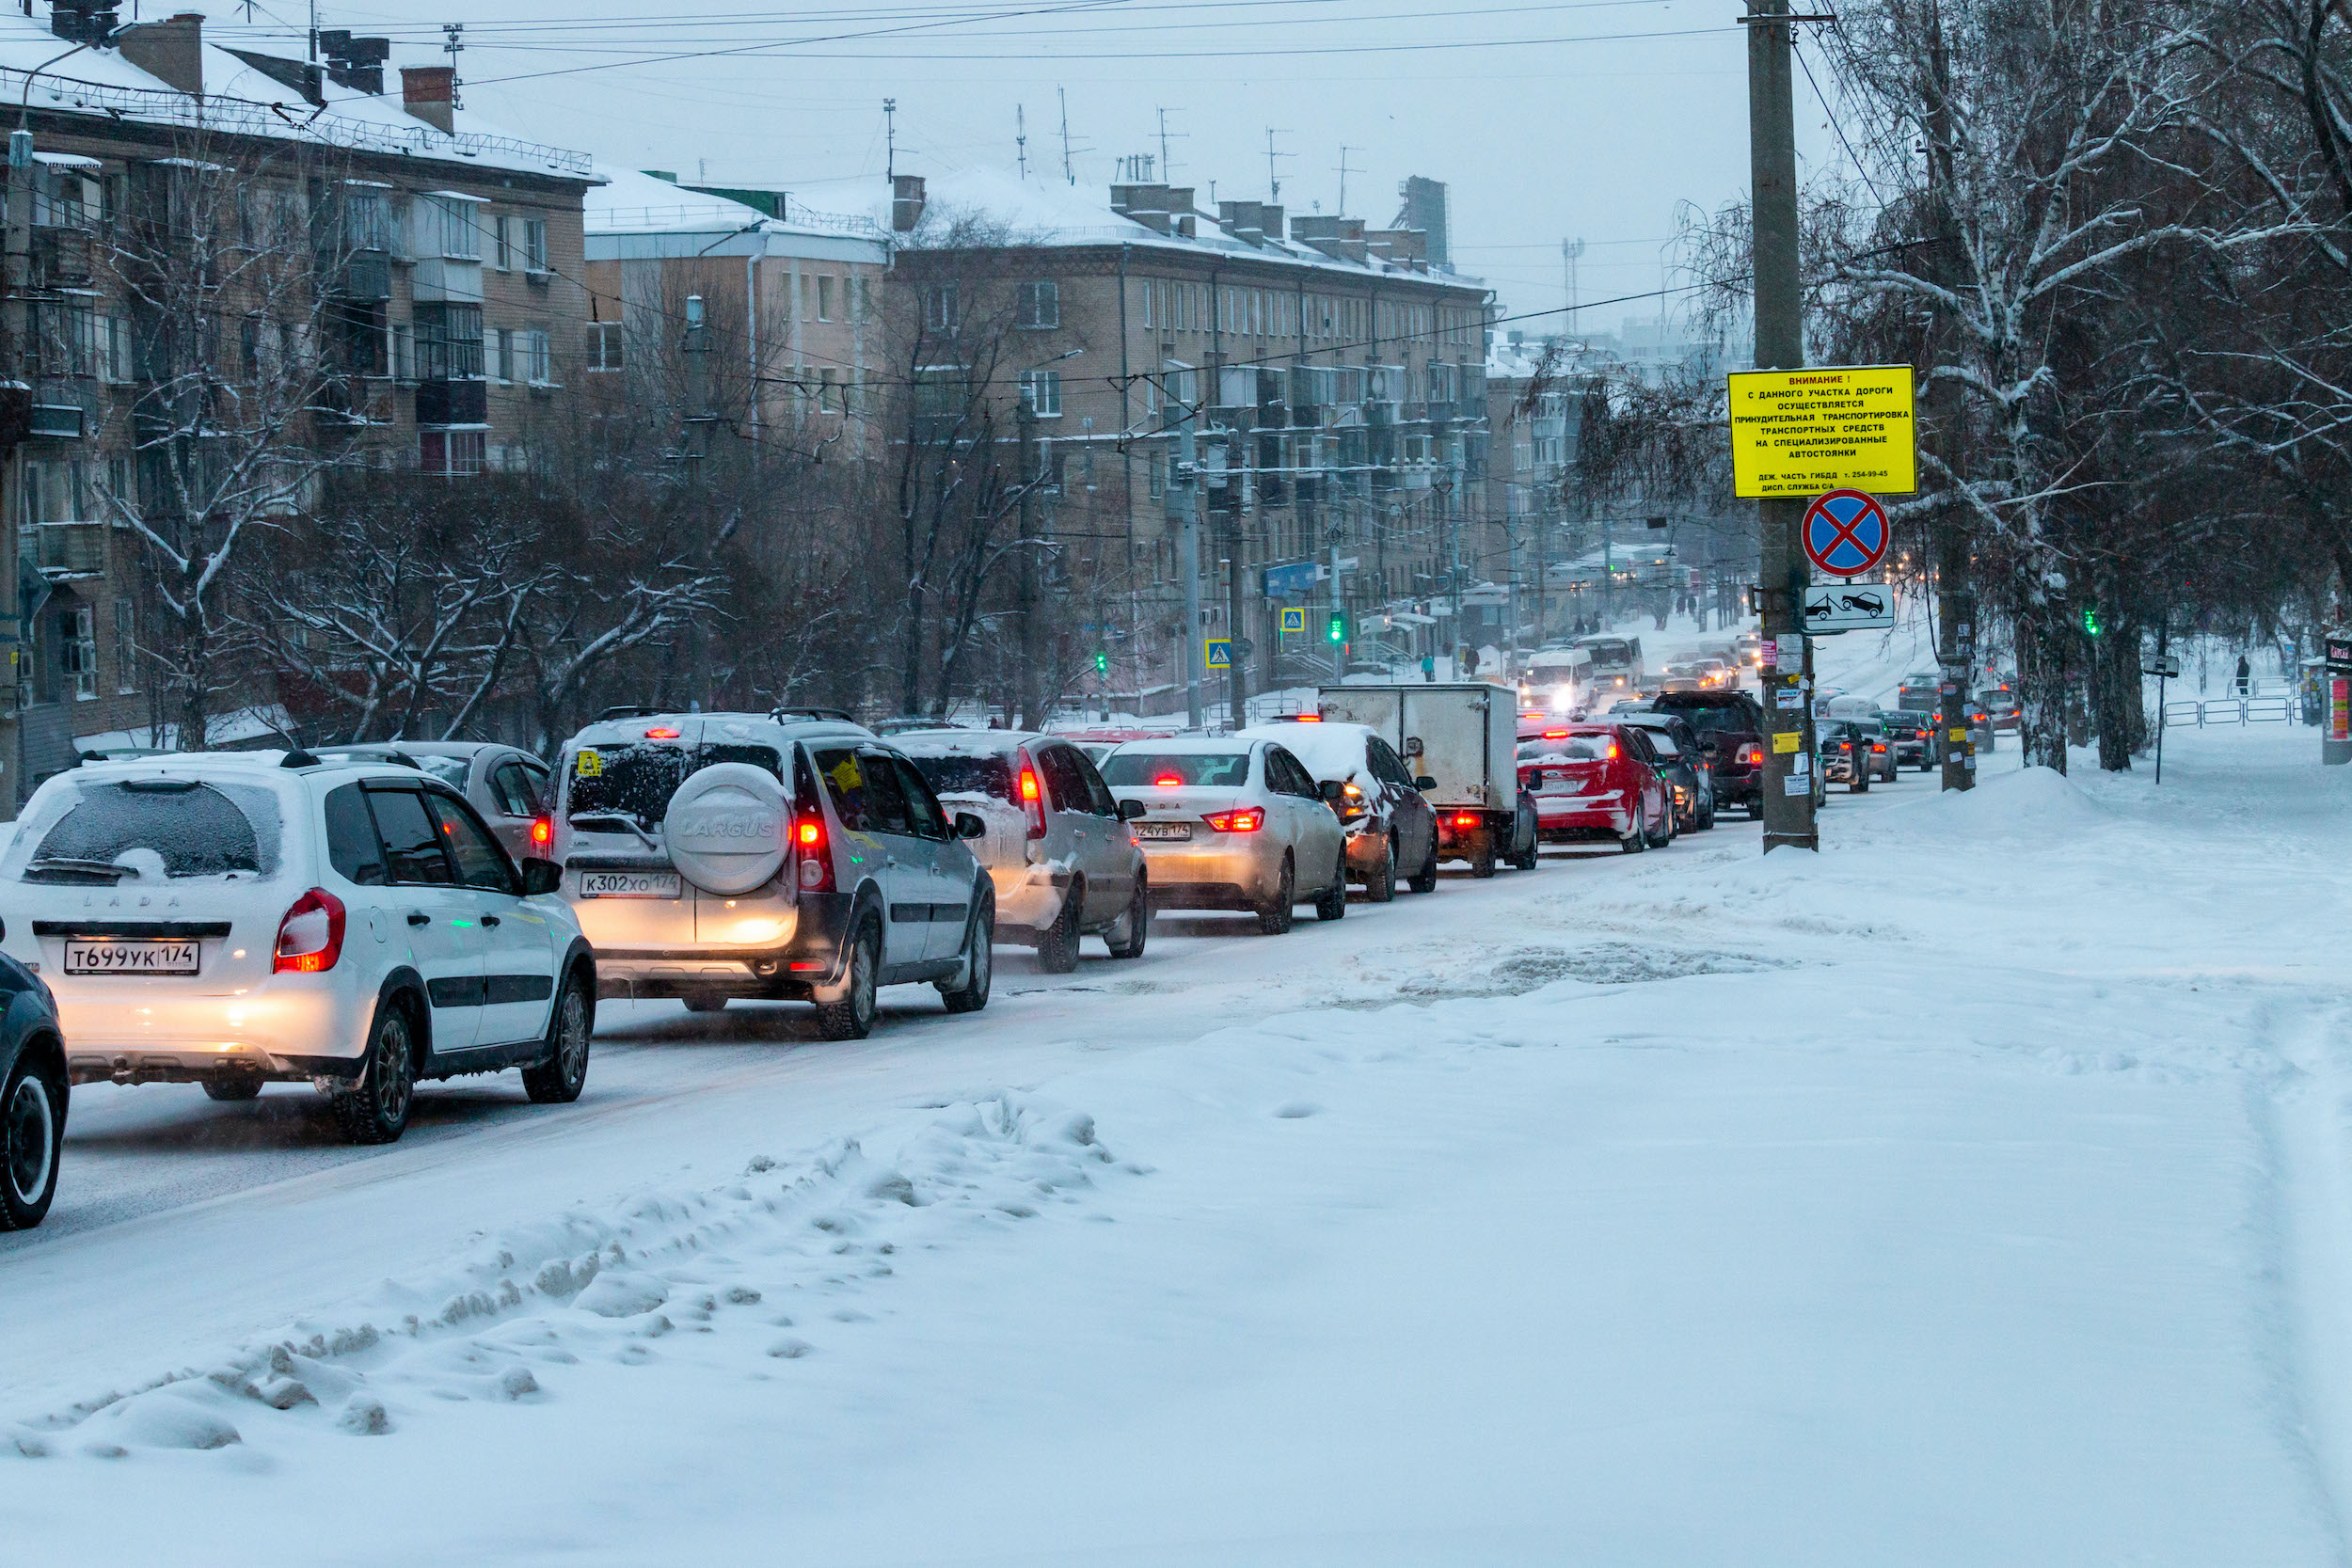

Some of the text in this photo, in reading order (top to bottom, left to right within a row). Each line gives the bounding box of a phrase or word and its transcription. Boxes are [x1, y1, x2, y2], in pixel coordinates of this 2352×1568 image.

[1788, 375, 1843, 386] ВНИМАНИЕ
[1758, 389, 1804, 400] ДАННОГО
[1808, 388, 1851, 397] УЧАСТКА
[1855, 387, 1893, 396] ДОРОГИ
[1777, 400, 1864, 411] ОСУЩЕСТВЛЯЕТСЯ
[1735, 410, 1909, 424] ПРИНУДИТЕЛЬНАЯ ТРАНСПОРТИРОВКА
[1760, 424, 1884, 436] ТРАНСПОРТНЫХ СРЕДСТВ
[1773, 436, 1887, 447] СПЕЦИАЛИЗИРОВАННЫЕ
[1788, 449, 1856, 459] АВТОСТОЯНКИ
[1758, 473, 1778, 482] ДЕЖ.
[681, 821, 774, 837] LARGUS
[586, 875, 649, 892] К302ХО
[83, 895, 180, 907] LADA
[73, 944, 192, 967] Т699УК 174
